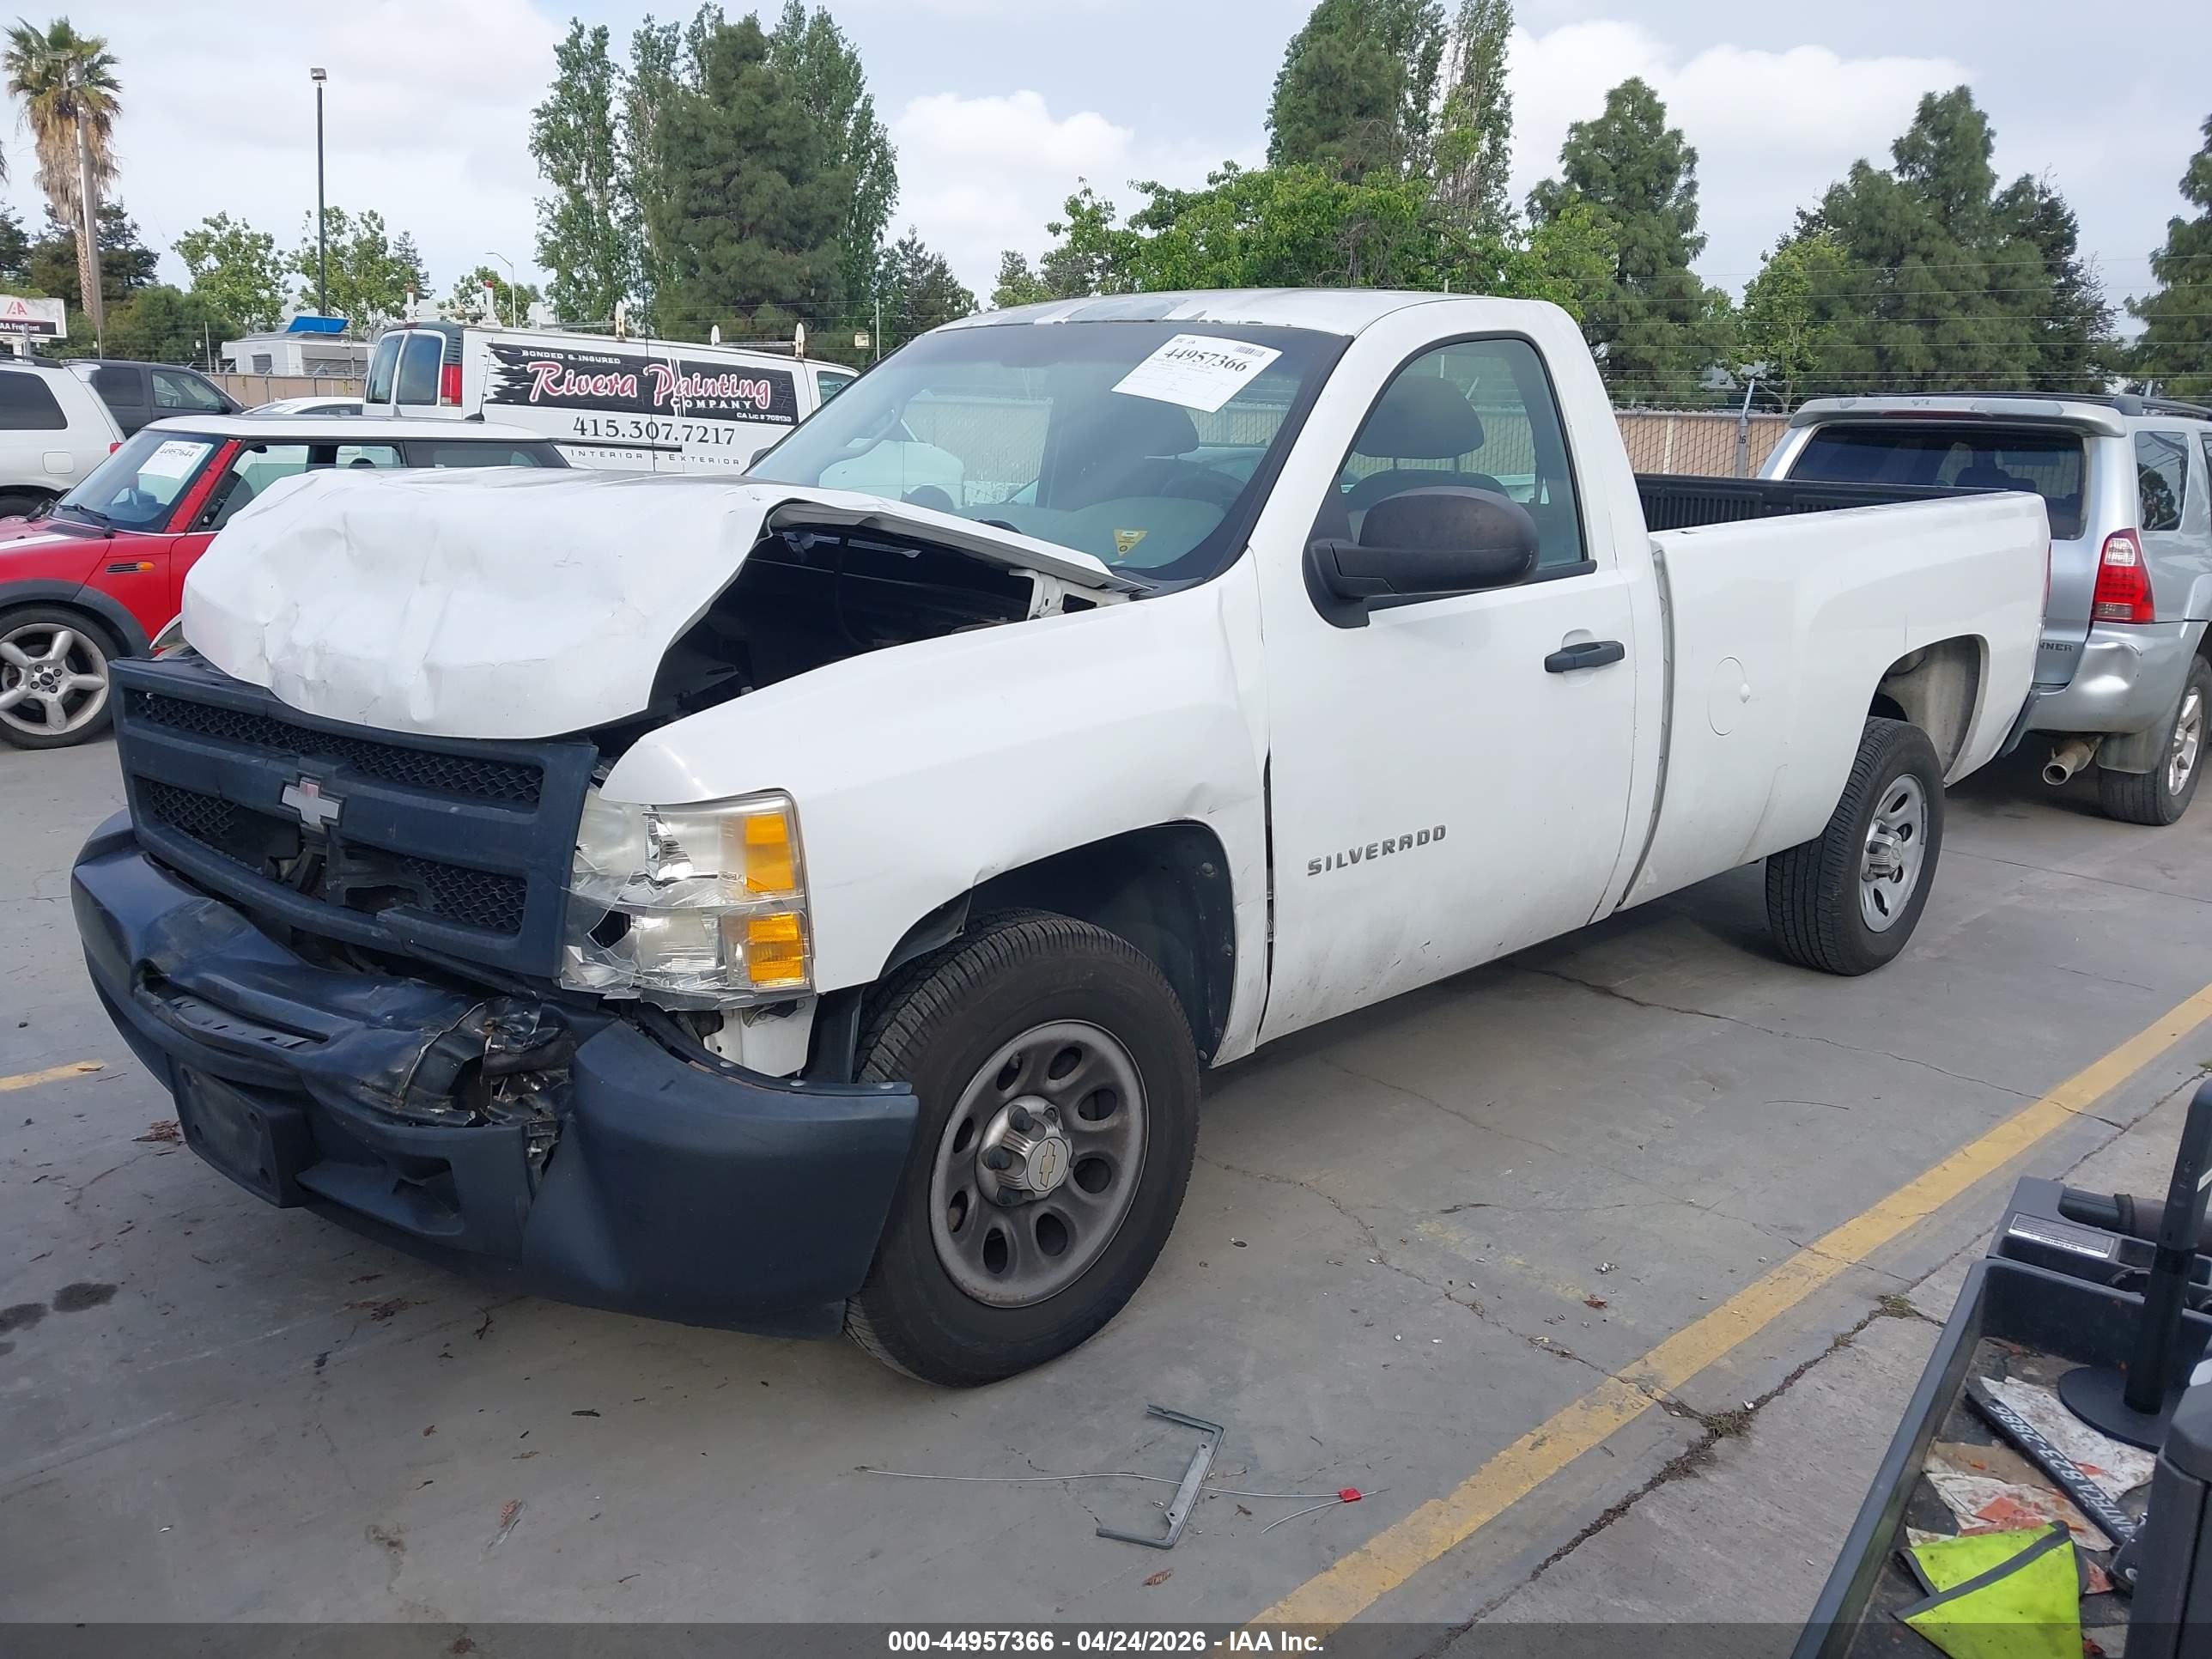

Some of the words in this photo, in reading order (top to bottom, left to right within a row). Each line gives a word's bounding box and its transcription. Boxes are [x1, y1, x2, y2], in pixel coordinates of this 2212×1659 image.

[11, 323, 40, 331] Freont
[522, 350, 564, 359] BONDED
[578, 356, 621, 364] INSURED
[1164, 348, 1253, 372] 44957366
[526, 361, 638, 402] Rivera
[643, 364, 771, 410] Painting
[670, 398, 753, 409] COMPANY
[573, 416, 736, 445] 415.307.7217
[570, 449, 643, 459] INTERIOR
[669, 454, 739, 465] EXTERIOR
[1307, 824, 1447, 877] SILVERADO
